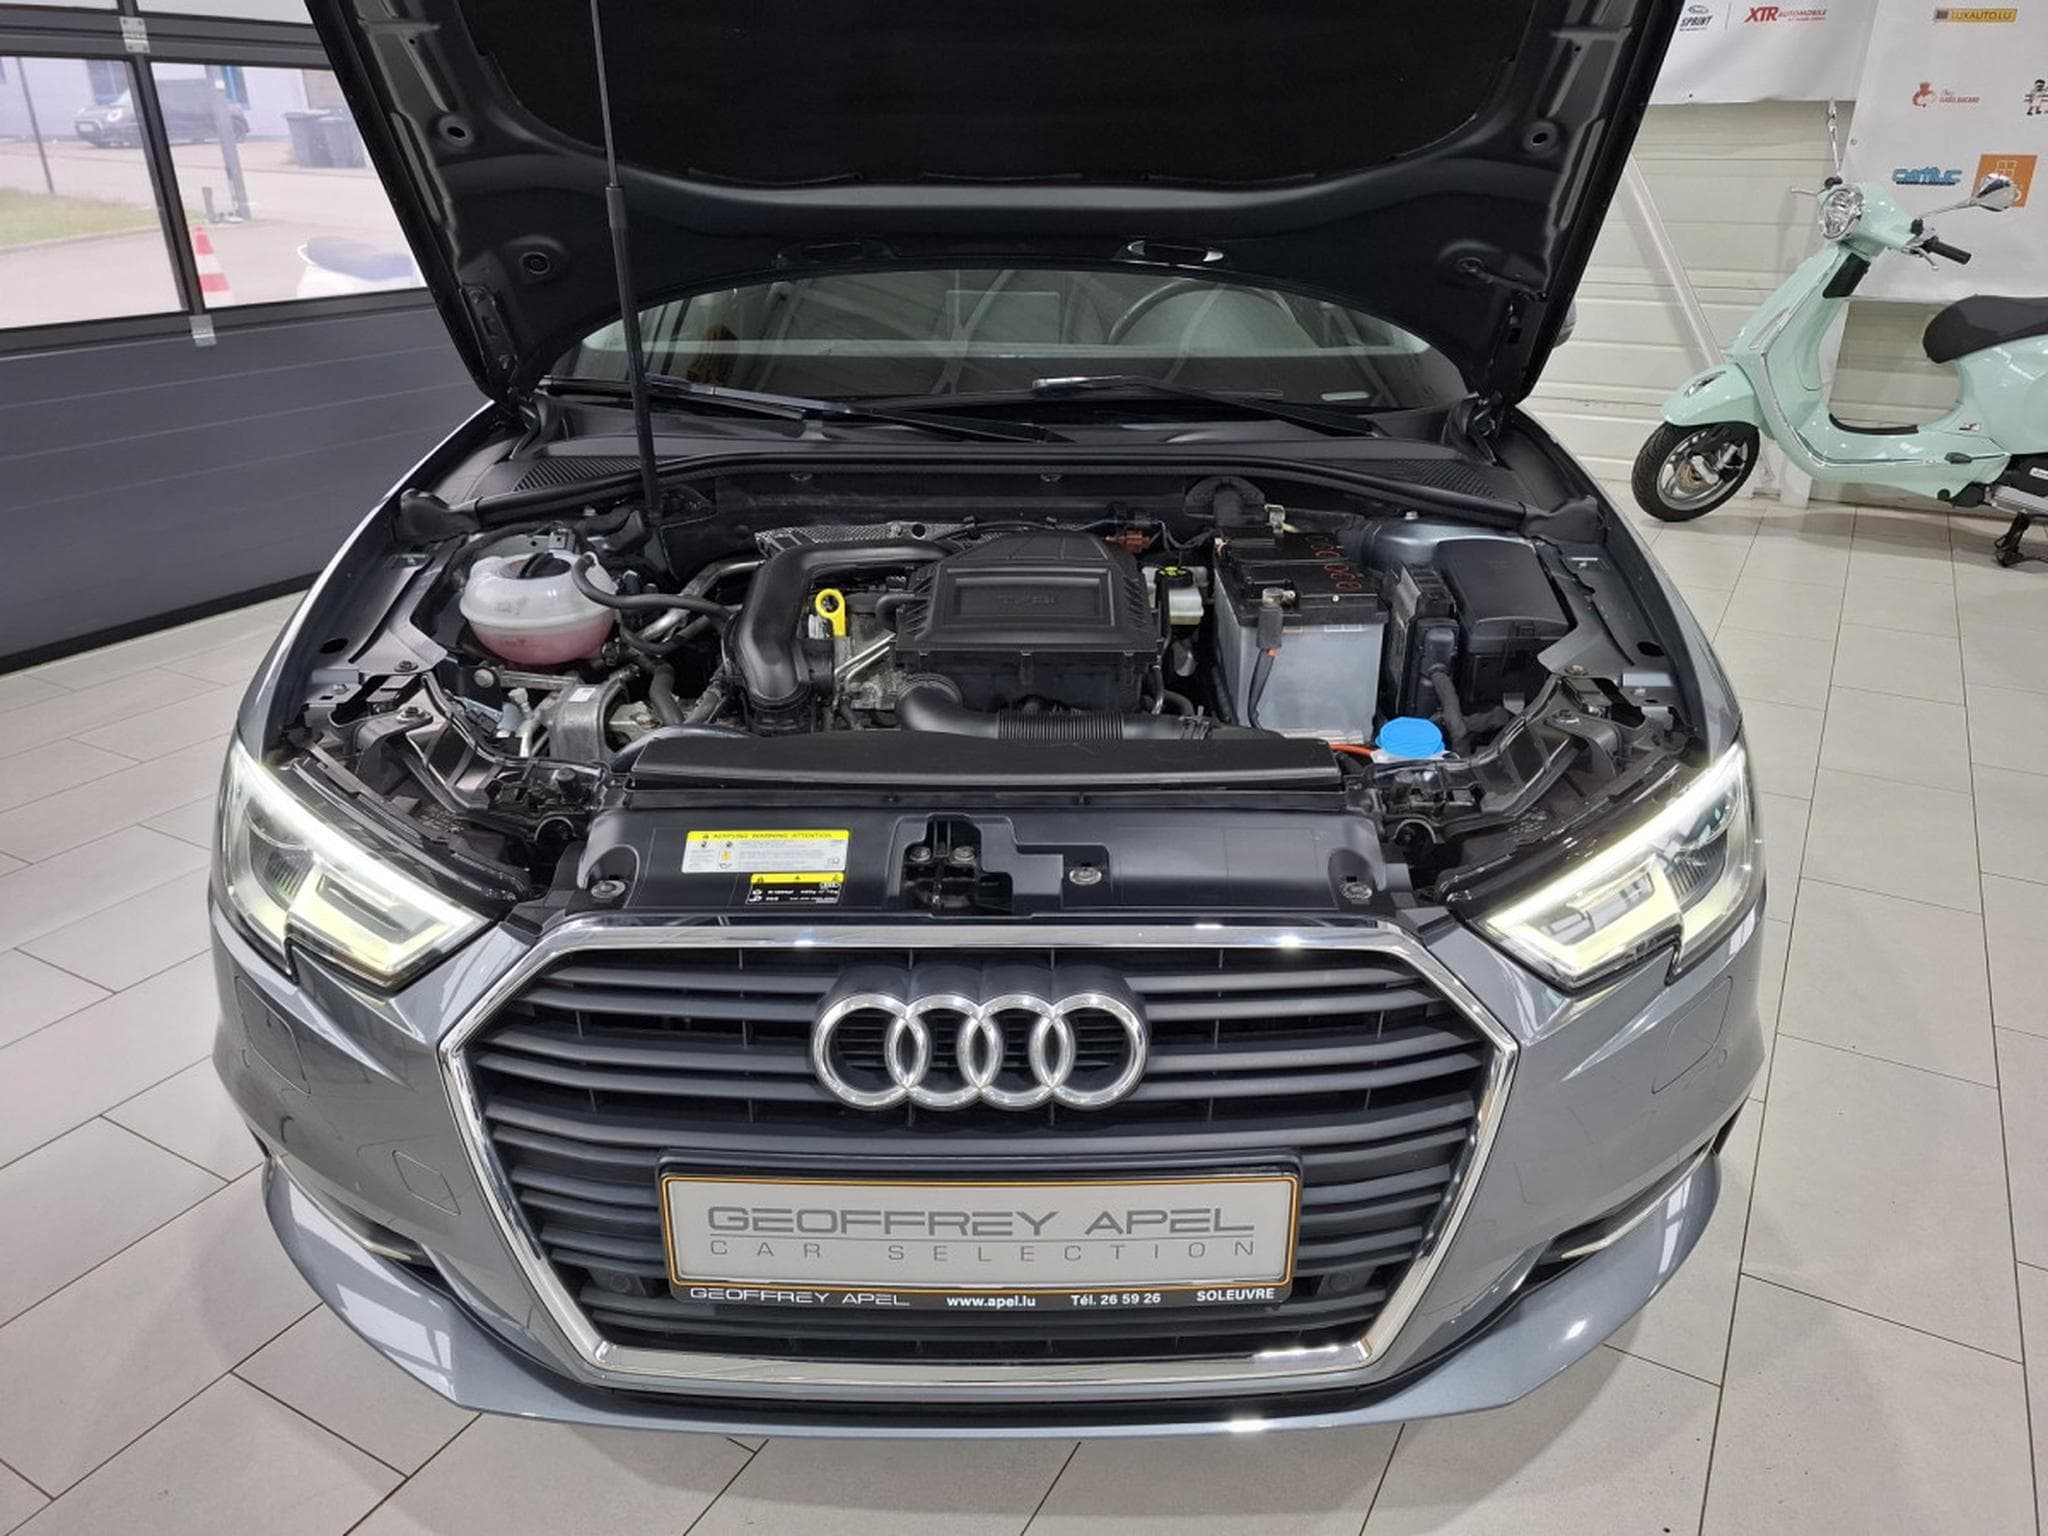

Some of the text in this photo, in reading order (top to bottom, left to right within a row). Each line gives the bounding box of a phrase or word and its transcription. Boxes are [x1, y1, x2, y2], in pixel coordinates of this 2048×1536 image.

[1680, 15, 1713, 27] SPRINT
[1744, 6, 1779, 23] XTR
[708, 1206, 1255, 1236] GEOFFREY APEL
[710, 1240, 1254, 1263] CAR SELECTION
[690, 1287, 1275, 1310] GEOFFREY APEL www.apel.lu Tél. 26 59 26 SOLEUVRE
